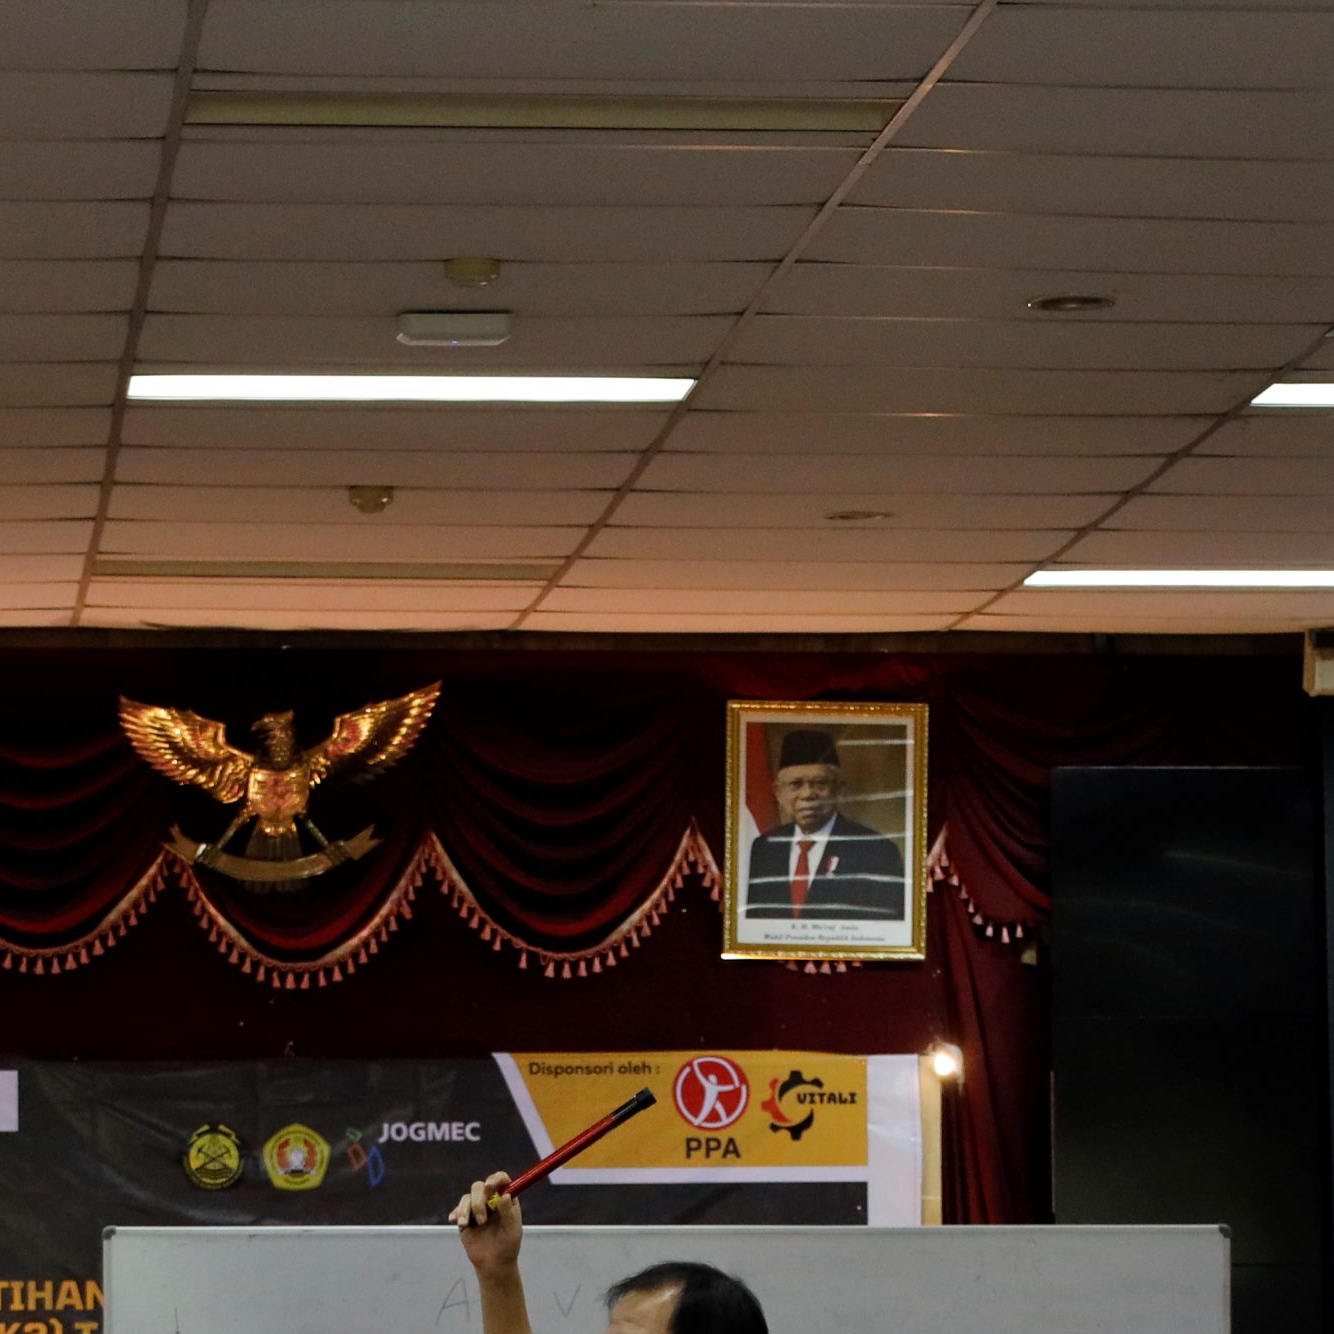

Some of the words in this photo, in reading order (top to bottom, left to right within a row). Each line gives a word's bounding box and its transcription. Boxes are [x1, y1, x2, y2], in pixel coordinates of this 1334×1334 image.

[528, 1060, 615, 1077] Disponsori
[617, 1061, 649, 1075] oleh
[796, 1092, 857, 1105] VITALI
[378, 1122, 481, 1143] JOGMEC
[686, 1137, 741, 1159] PPA
[435, 1276, 471, 1327] A
